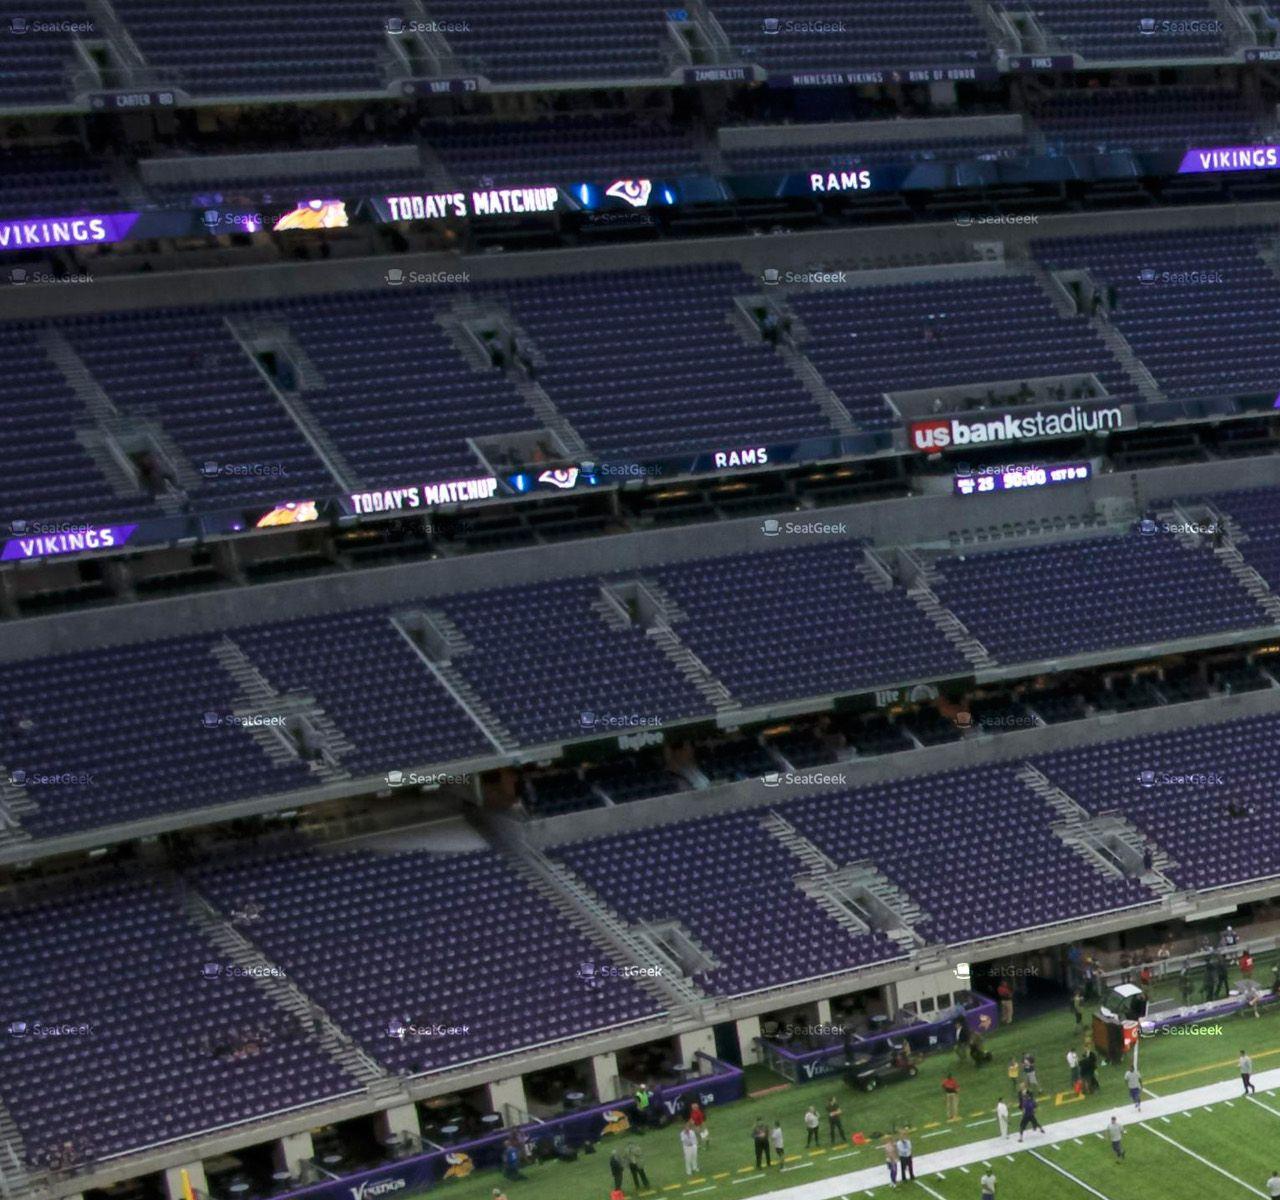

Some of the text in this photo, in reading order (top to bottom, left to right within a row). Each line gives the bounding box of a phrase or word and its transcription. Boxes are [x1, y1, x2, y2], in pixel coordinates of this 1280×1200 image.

[792, 74, 843, 85] MINNESOTA
[847, 72, 883, 84] VIKINGS
[909, 71, 929, 81] RING
[1200, 148, 1277, 169] VIKINGS
[811, 171, 871, 191] RAMS
[388, 187, 558, 221] TODAY'S MATCHUP
[0, 219, 106, 246] VIKINGS
[714, 447, 768, 468] RAMS
[351, 477, 497, 514] TODAY'S MATCHUP
[20, 528, 114, 556] VIKINGS
